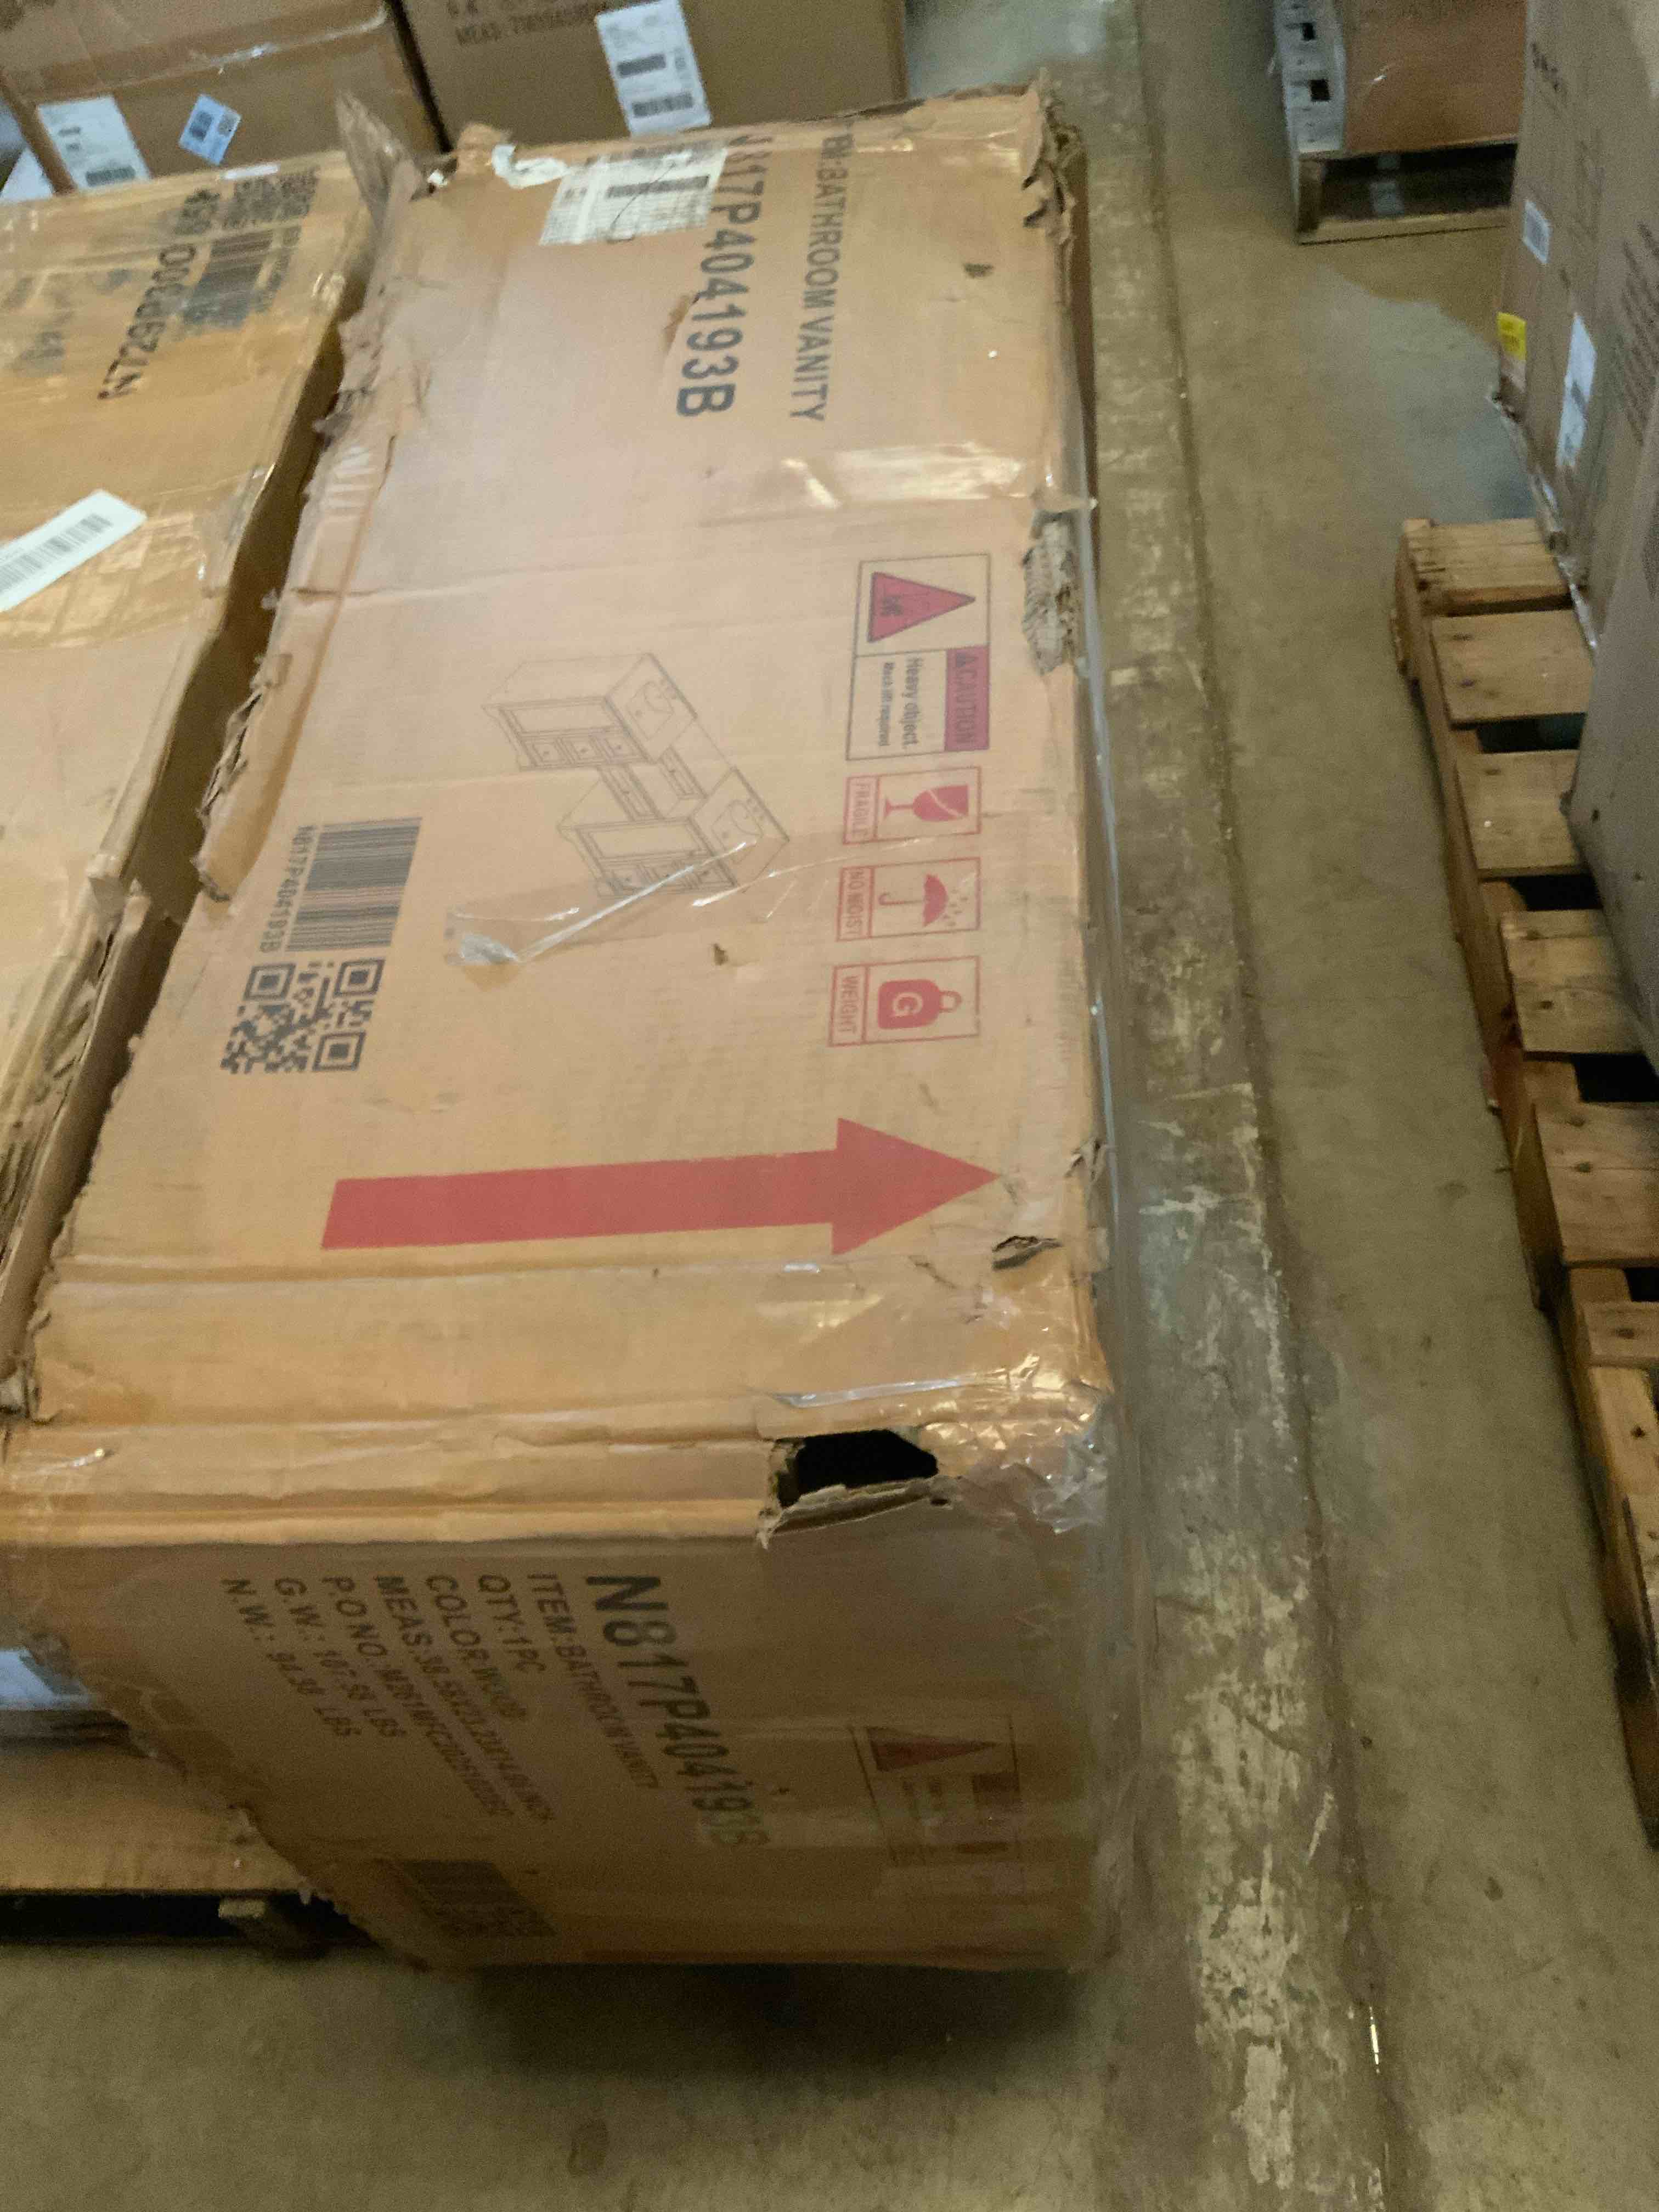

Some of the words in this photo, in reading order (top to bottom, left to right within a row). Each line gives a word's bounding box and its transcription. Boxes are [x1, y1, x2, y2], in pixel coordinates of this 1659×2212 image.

[789, 314, 835, 422] VANITY
[901, 657, 924, 698] Heavy
[956, 669, 978, 743] CAUTION
[851, 780, 871, 838] FRAGILE
[848, 868, 866, 890] NO
[845, 892, 865, 936] MOIST
[839, 975, 859, 1034] WEIGHT
